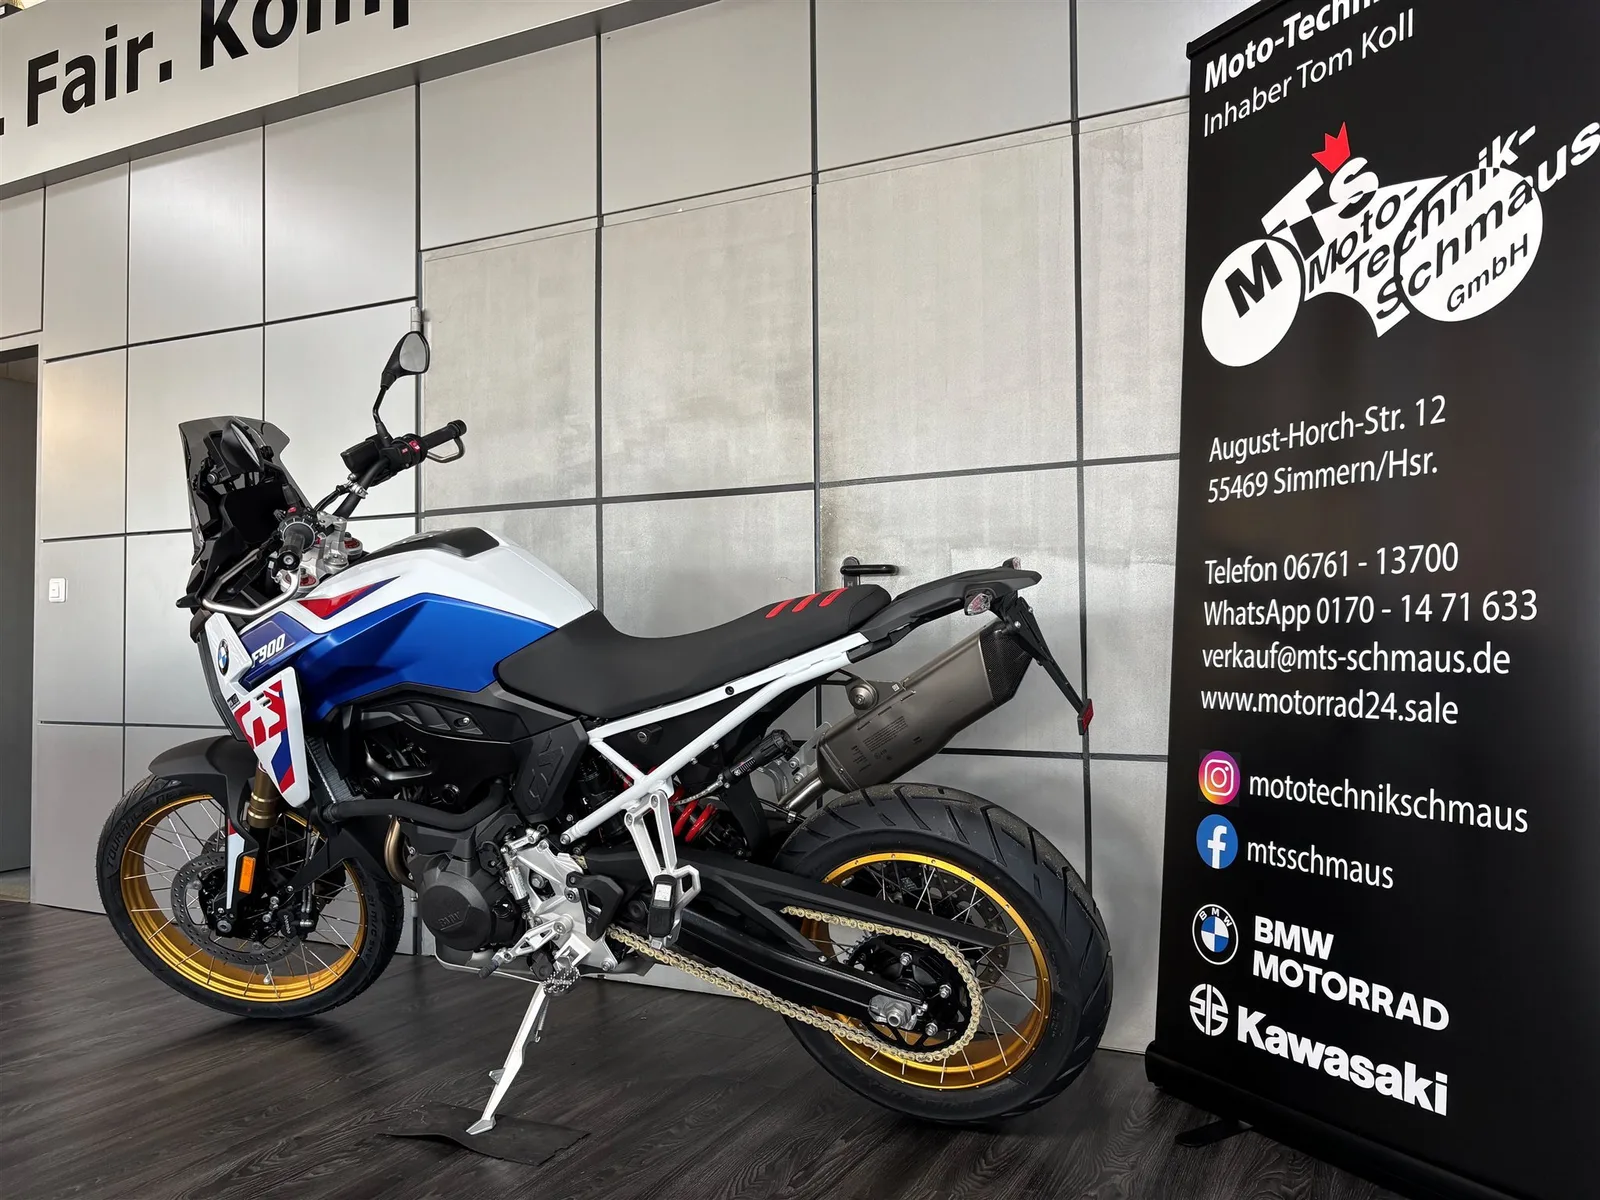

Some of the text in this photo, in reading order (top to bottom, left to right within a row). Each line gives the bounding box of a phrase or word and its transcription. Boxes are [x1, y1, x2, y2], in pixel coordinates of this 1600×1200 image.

[27, 23, 173, 128] Fair.
[1203, 8, 1414, 137] Inhaber Tom Koll
[1308, 185, 1418, 293] Moto-
[1344, 125, 1536, 295] Technik-
[1446, 233, 1529, 313] GmbH
[1209, 394, 1447, 464] August-Horch-Str. 12
[1207, 448, 1438, 503] 55469 Simmern/Hsr.
[1205, 555, 1278, 585] Telefon
[1283, 550, 1349, 582] 06761
[1376, 541, 1459, 575] 13700
[1204, 598, 1311, 632] WhatsApp
[1316, 595, 1375, 624] 0170
[1401, 594, 1433, 623] 14
[1441, 592, 1471, 622] 71
[1482, 588, 1538, 621] 633
[1202, 641, 1511, 675] verkauf@mts-schmaus.de
[1201, 689, 1459, 725] www.motorrad24.sale
[1249, 774, 1529, 833] mototechnikschmaus
[1247, 839, 1394, 889] mtsschmaus
[1199, 907, 1233, 927] BMW
[1254, 915, 1334, 960] BMW
[1252, 950, 1450, 1031] MOTORRAD
[1237, 1005, 1448, 1116] Kawasaki
